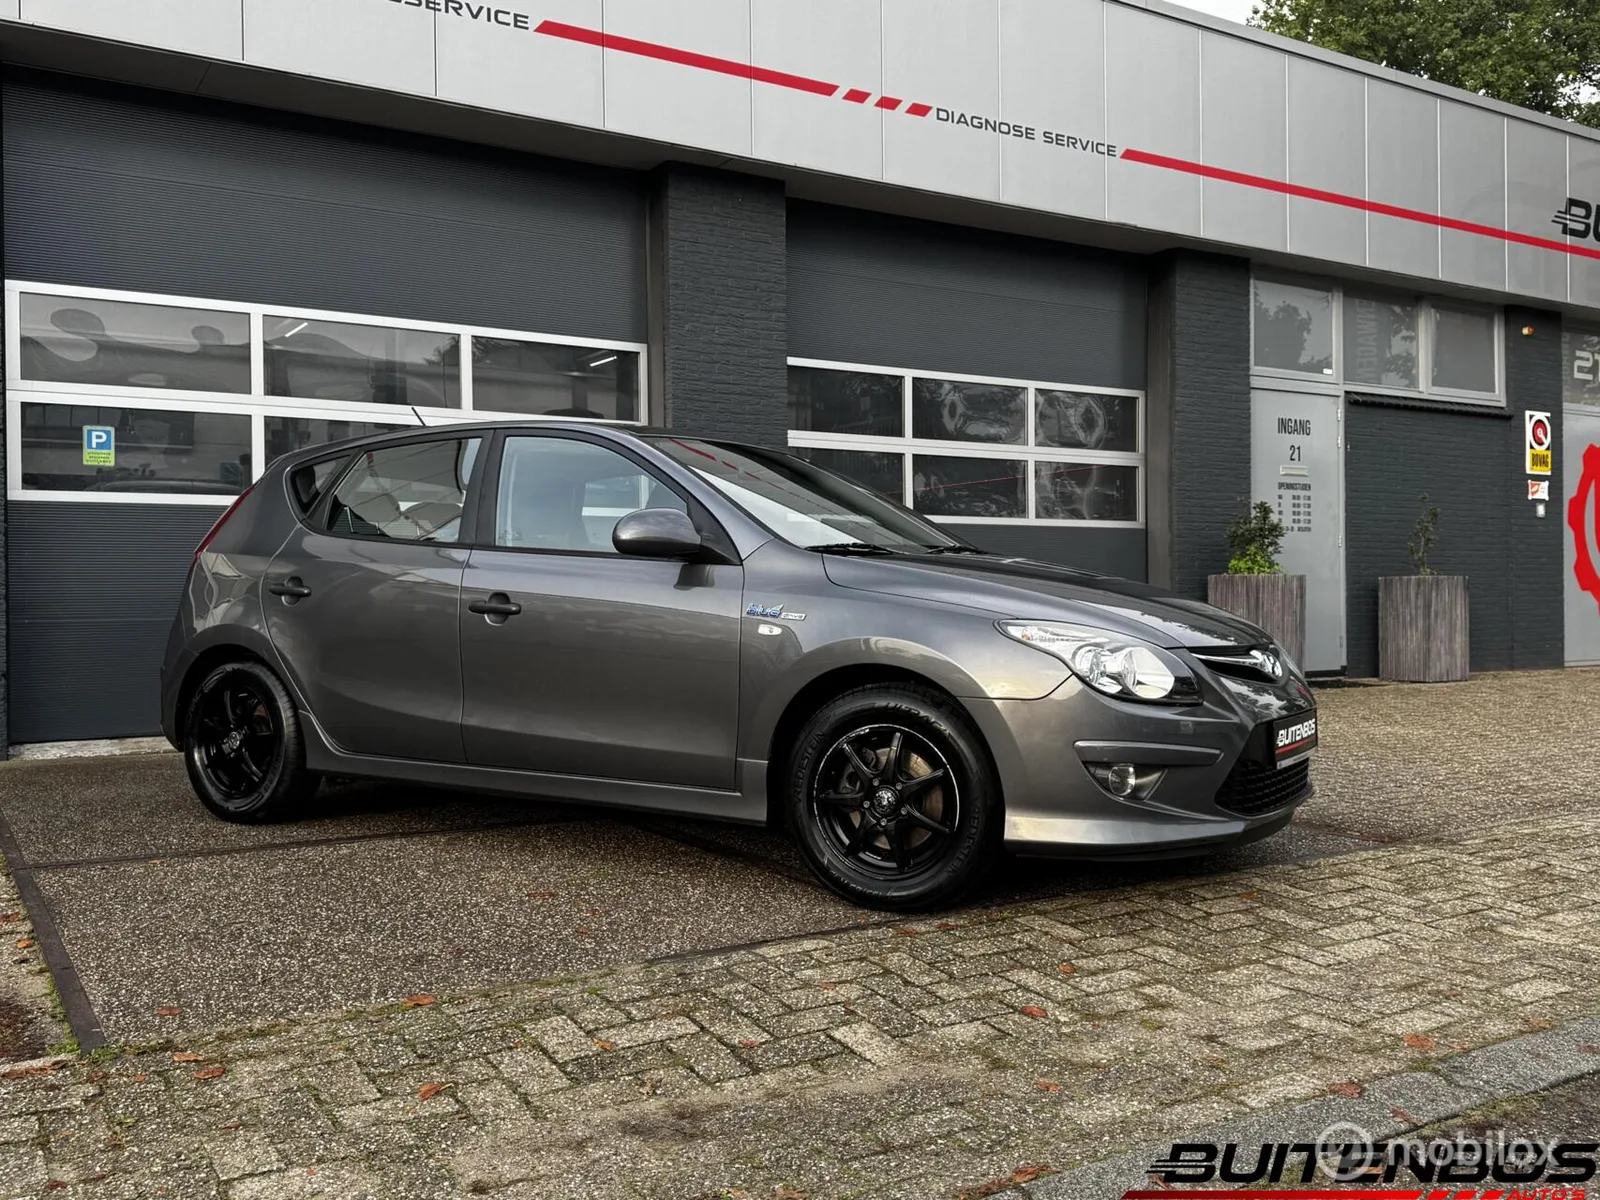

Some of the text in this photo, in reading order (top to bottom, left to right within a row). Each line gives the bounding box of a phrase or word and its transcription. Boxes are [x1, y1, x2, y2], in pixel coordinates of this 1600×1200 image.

[936, 107, 1117, 157] DIAGNOSE SERVICE
[1277, 417, 1311, 436] INGANG
[91, 430, 107, 449] P
[1289, 444, 1301, 462] 21
[1531, 453, 1549, 468] BOVAG
[1276, 718, 1316, 747] BUITENBOS
